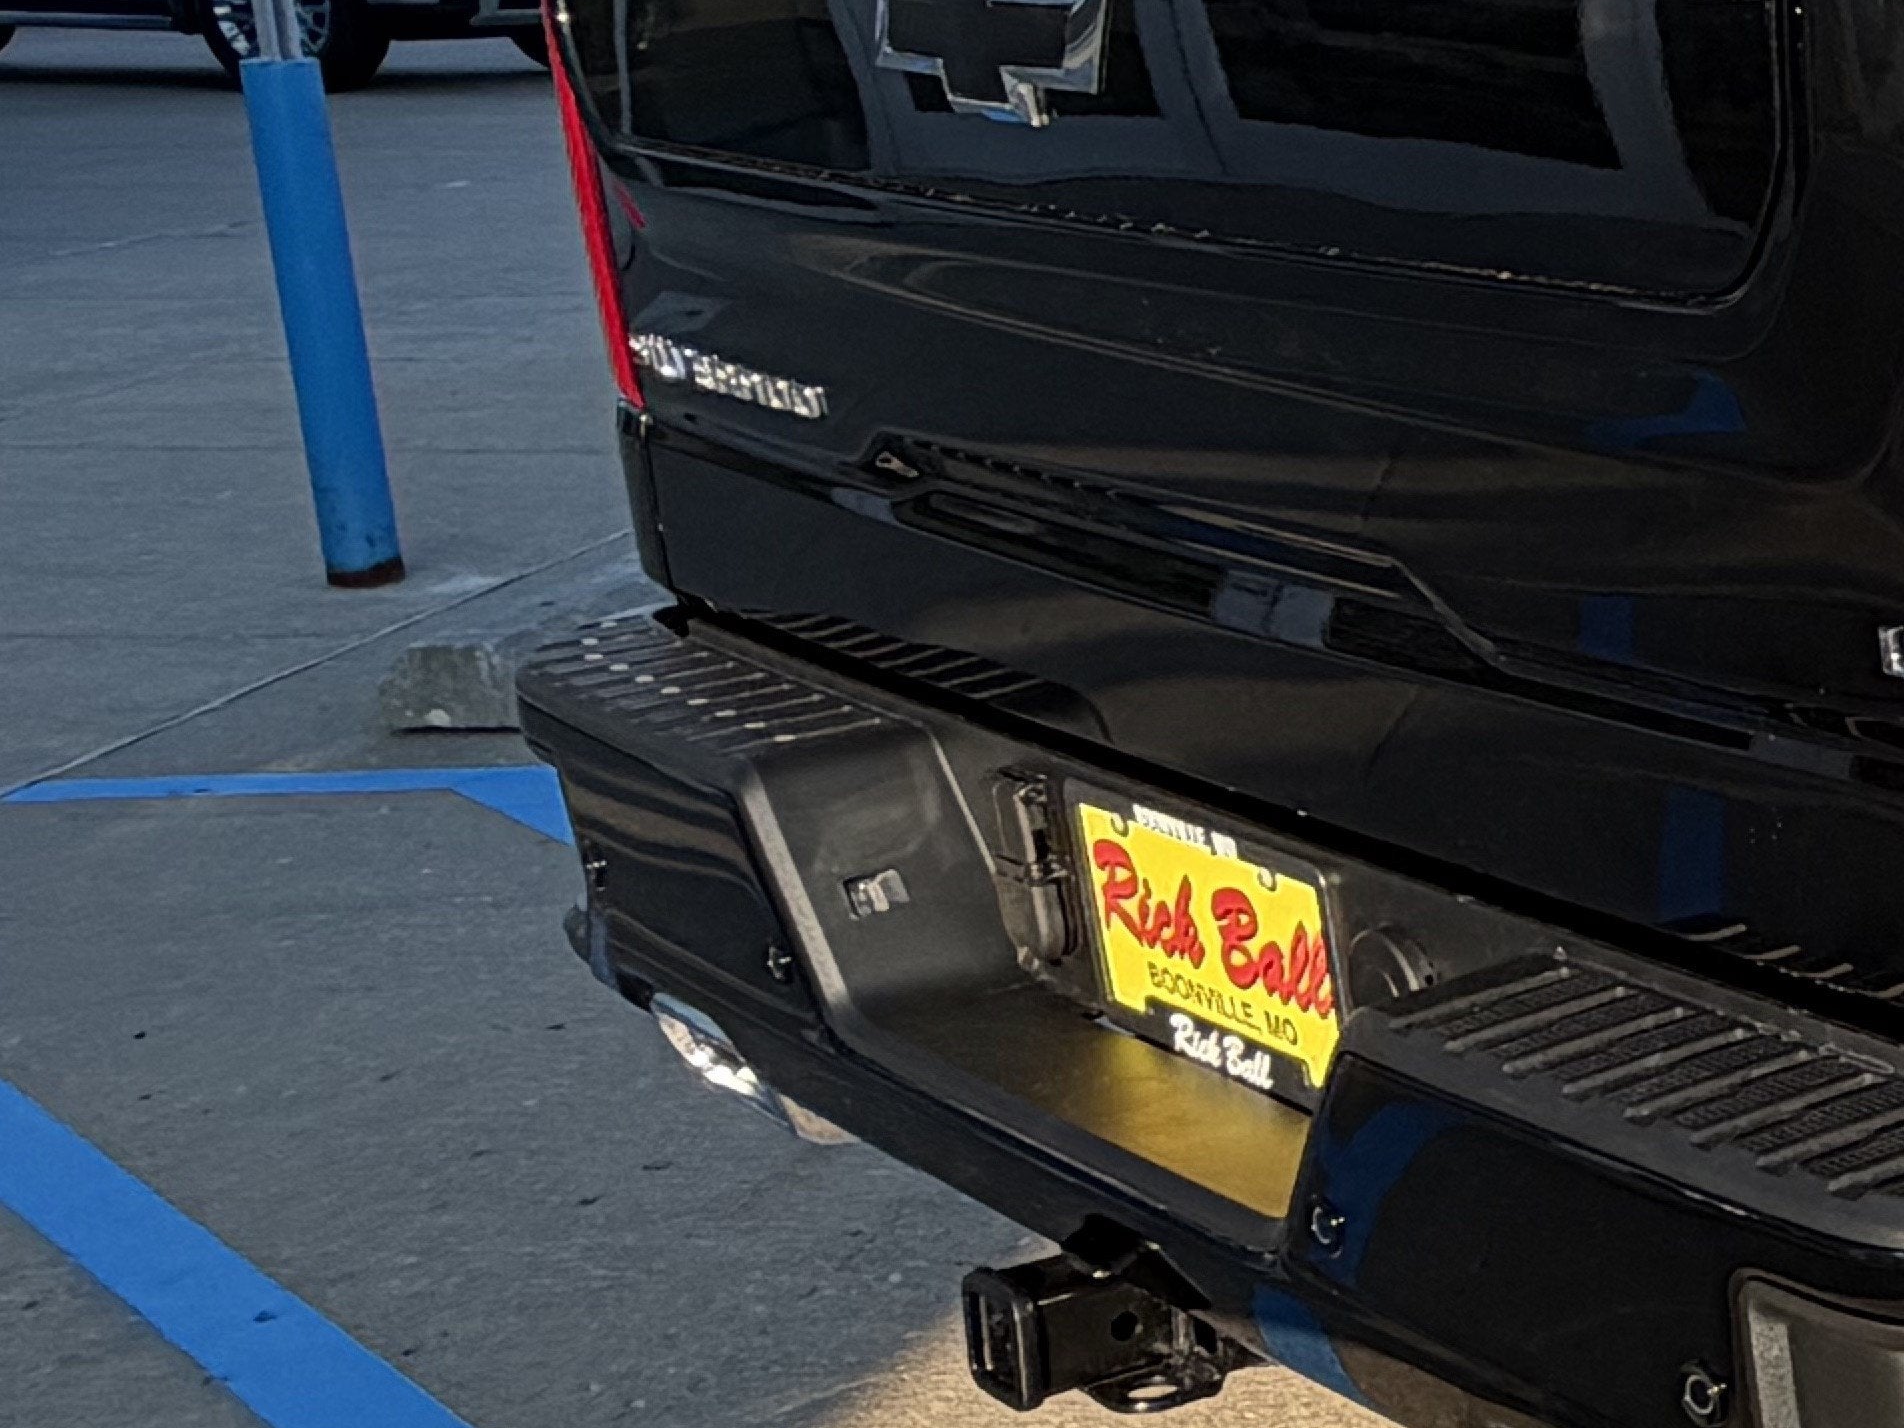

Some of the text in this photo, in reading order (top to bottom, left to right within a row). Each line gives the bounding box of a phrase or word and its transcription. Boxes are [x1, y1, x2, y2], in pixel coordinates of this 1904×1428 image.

[1093, 839, 1336, 1019] Rick Ball
[1169, 1014, 1274, 1090] Rick Ball
[1265, 1013, 1298, 1046] MO
